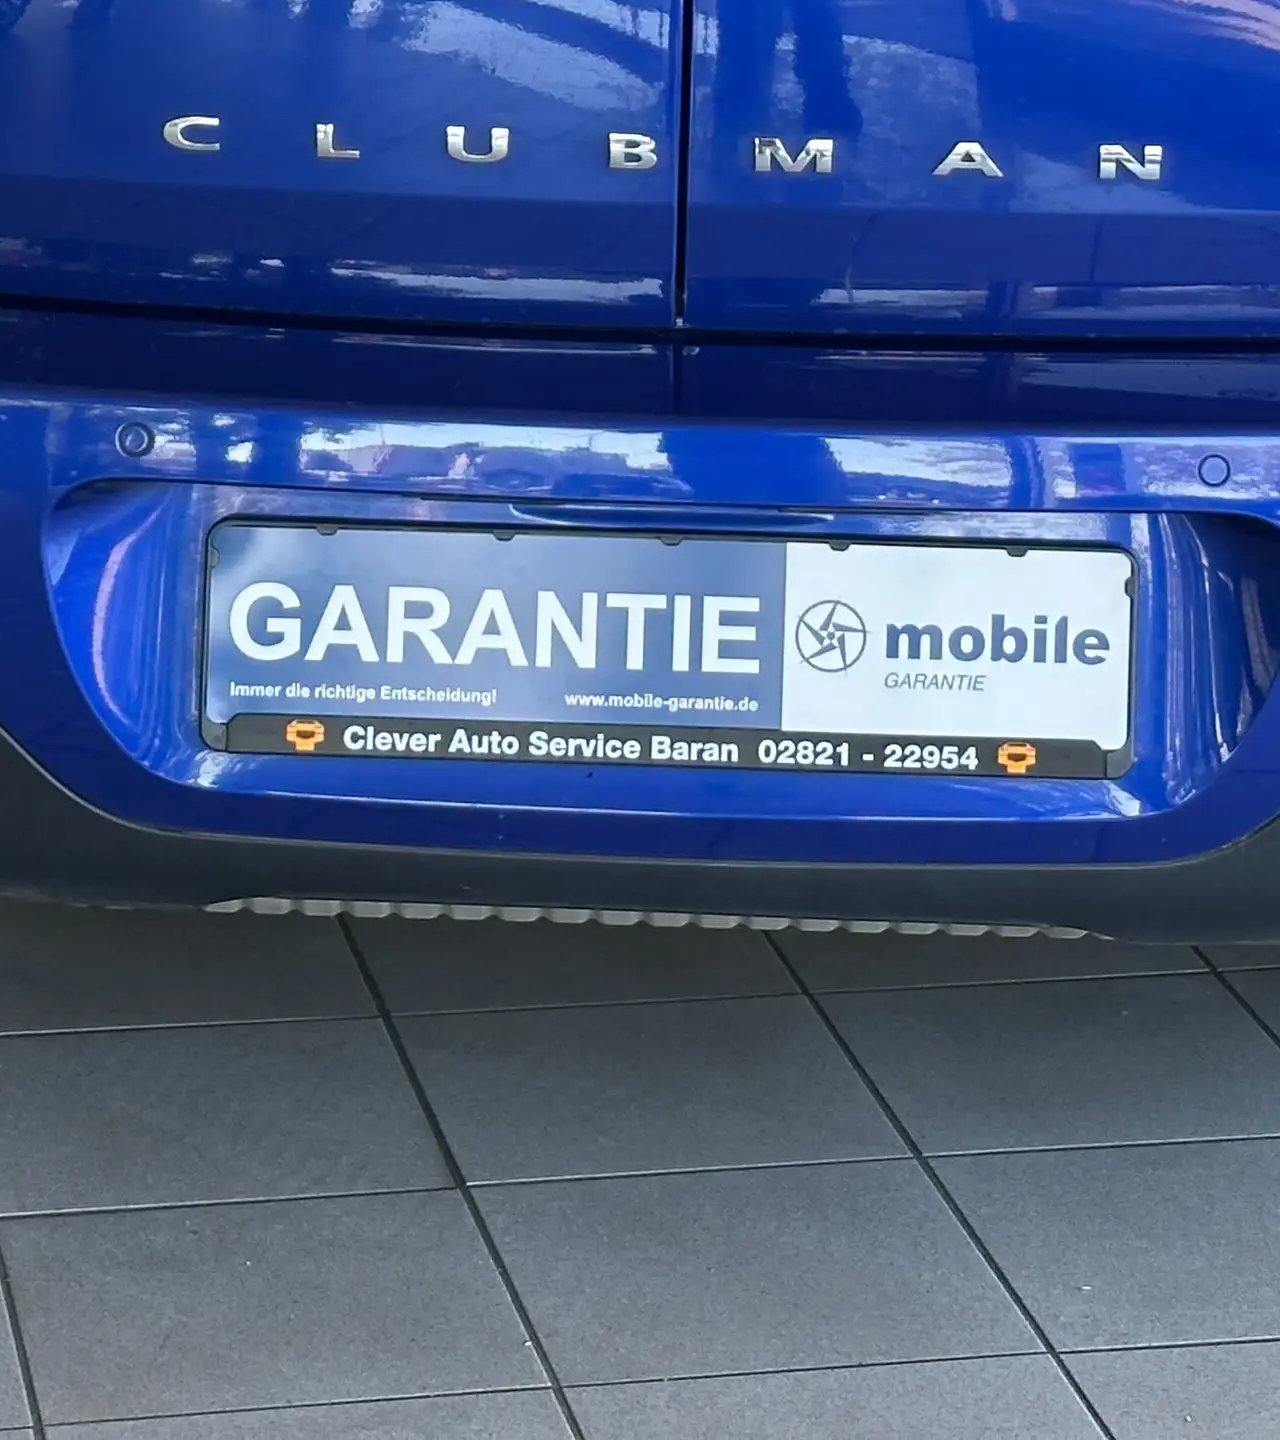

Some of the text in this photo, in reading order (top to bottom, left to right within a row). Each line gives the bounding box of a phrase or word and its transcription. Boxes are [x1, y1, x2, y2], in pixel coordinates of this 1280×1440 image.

[163, 115, 1163, 181] CLUBMAN
[228, 580, 761, 674] GARANTIE
[885, 613, 1111, 666] mobile
[229, 682, 498, 707] Immer die richtige Entscheidung!
[564, 692, 759, 712] www.mobile-garantie.de
[883, 672, 988, 692] GARANTIE
[342, 725, 442, 753] Clever
[447, 728, 520, 755] Auto
[528, 730, 641, 760] Service
[651, 735, 739, 762] Baran
[757, 739, 850, 766] 02821
[883, 744, 979, 771] 22954
